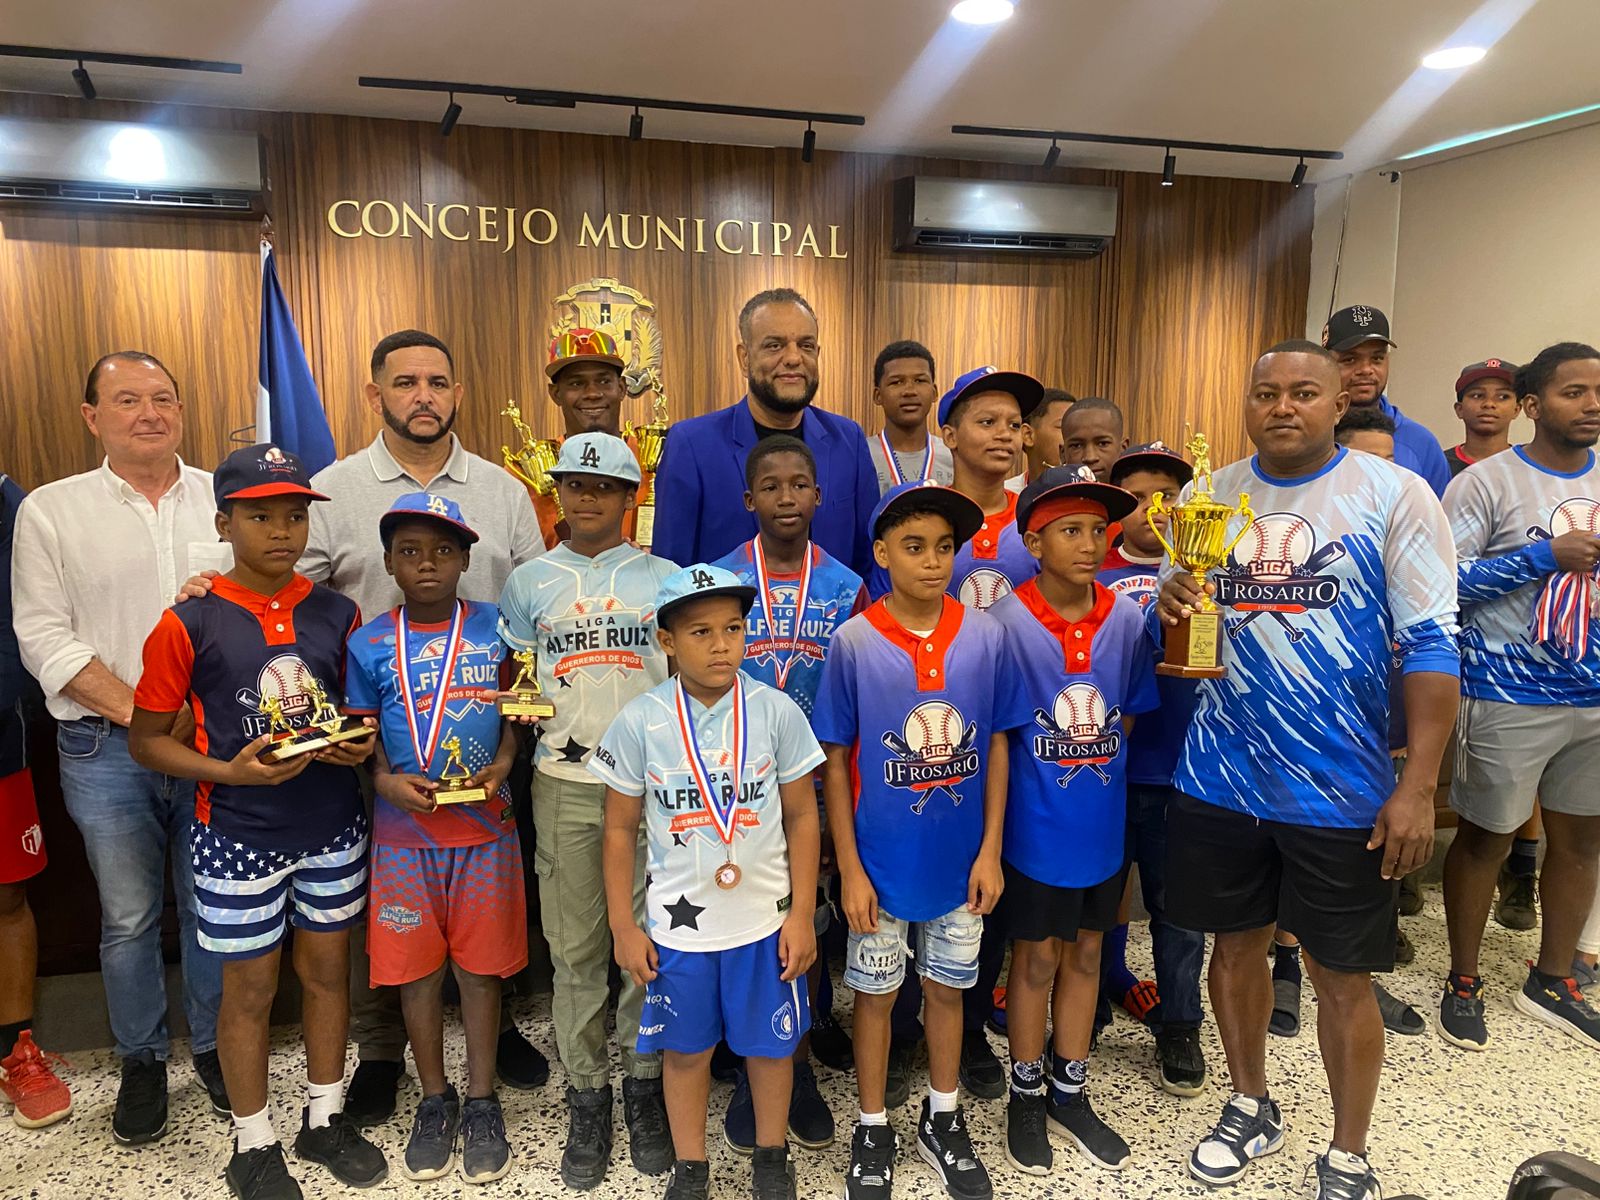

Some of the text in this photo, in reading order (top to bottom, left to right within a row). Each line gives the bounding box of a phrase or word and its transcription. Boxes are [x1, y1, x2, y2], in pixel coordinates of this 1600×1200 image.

[327, 200, 848, 260] CONCEJO MUNICIPAL
[580, 442, 600, 468] LA
[427, 494, 448, 515] LA
[1250, 562, 1292, 575] LIGA
[690, 569, 716, 589] LA
[1214, 576, 1338, 602] FROSARIO
[575, 617, 616, 629] LIGA
[546, 627, 650, 654] ALFRE RUIZ
[557, 655, 606, 671] GUERREROS
[622, 657, 640, 665] DIOS
[461, 664, 497, 684] RUIZ
[280, 695, 310, 709] LIGA
[1069, 725, 1100, 737] LIGA
[920, 745, 953, 759] LIGA
[687, 772, 731, 785] LGA
[721, 780, 765, 806] RUIZ
